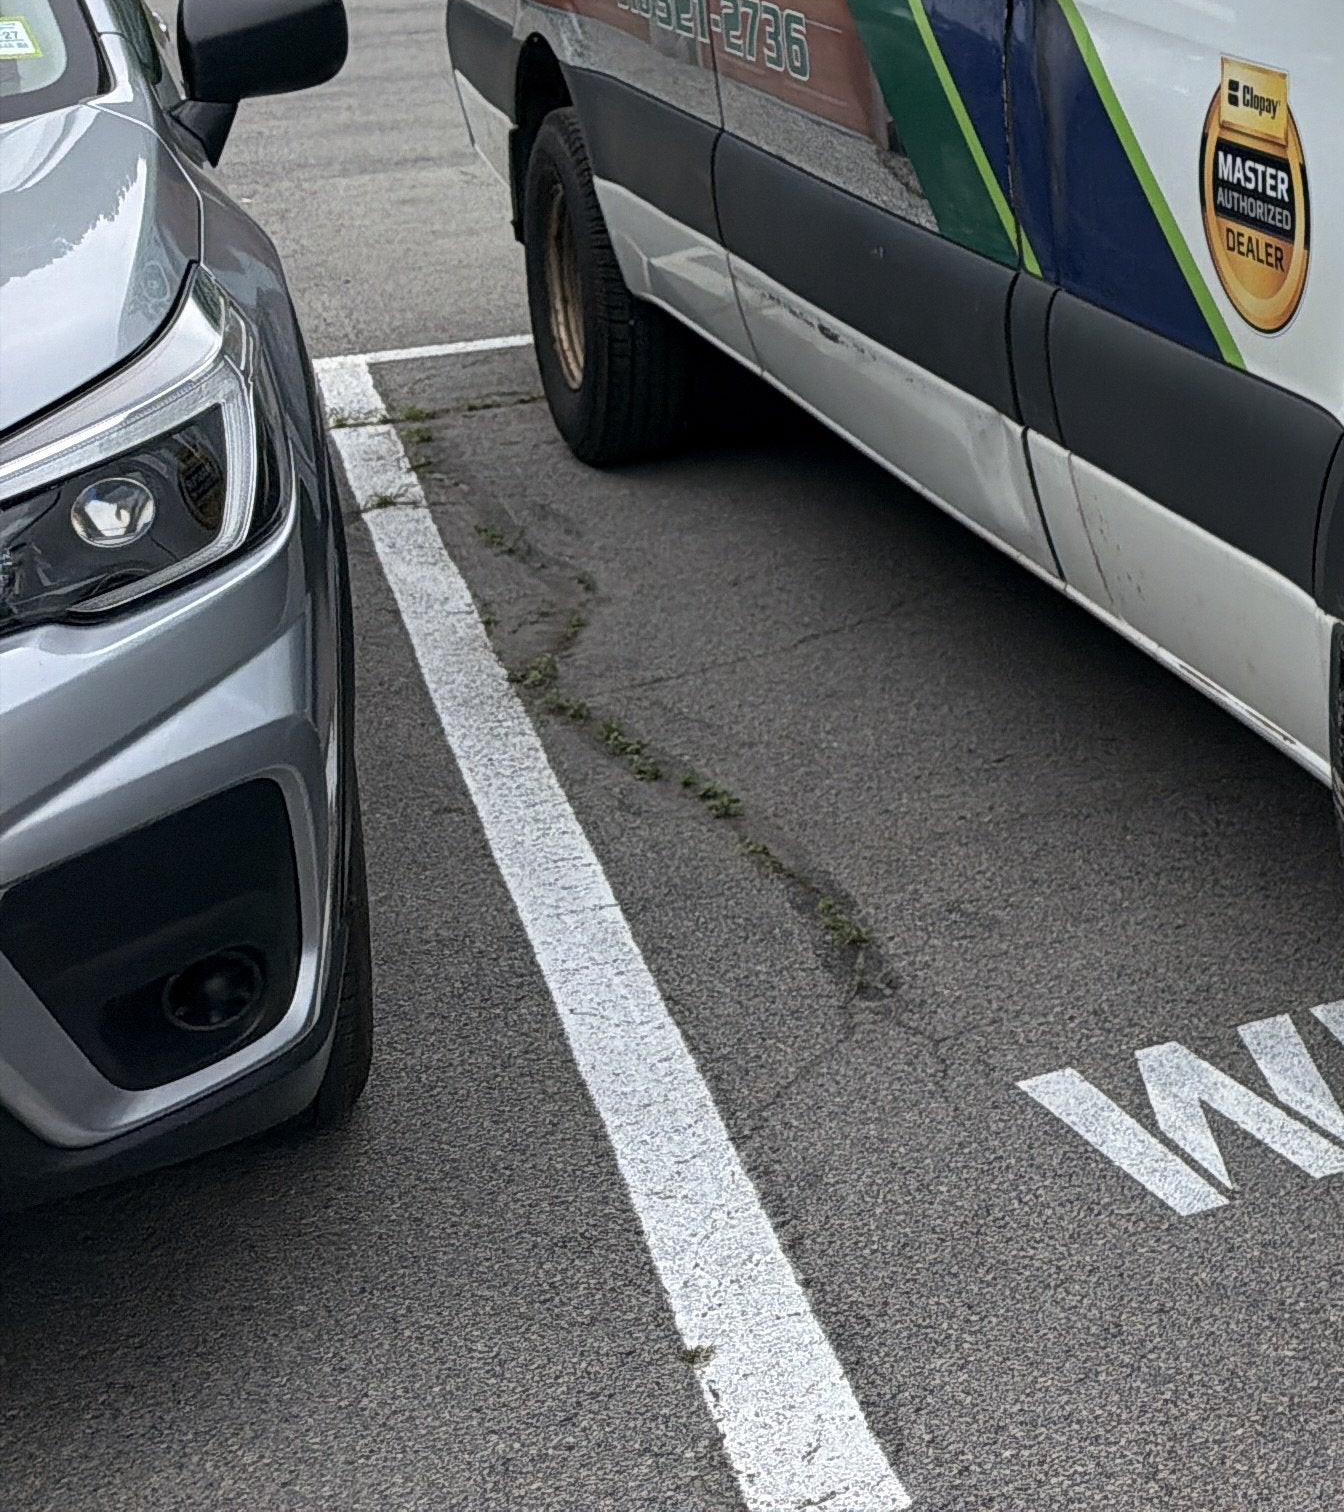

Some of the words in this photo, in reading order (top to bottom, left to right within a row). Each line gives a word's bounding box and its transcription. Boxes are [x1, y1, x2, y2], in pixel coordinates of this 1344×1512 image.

[1242, 84, 1281, 120] Clopay
[1217, 149, 1290, 203] MASTER
[1216, 187, 1292, 232] AUTHORIZED
[1226, 227, 1285, 273] DEALER
